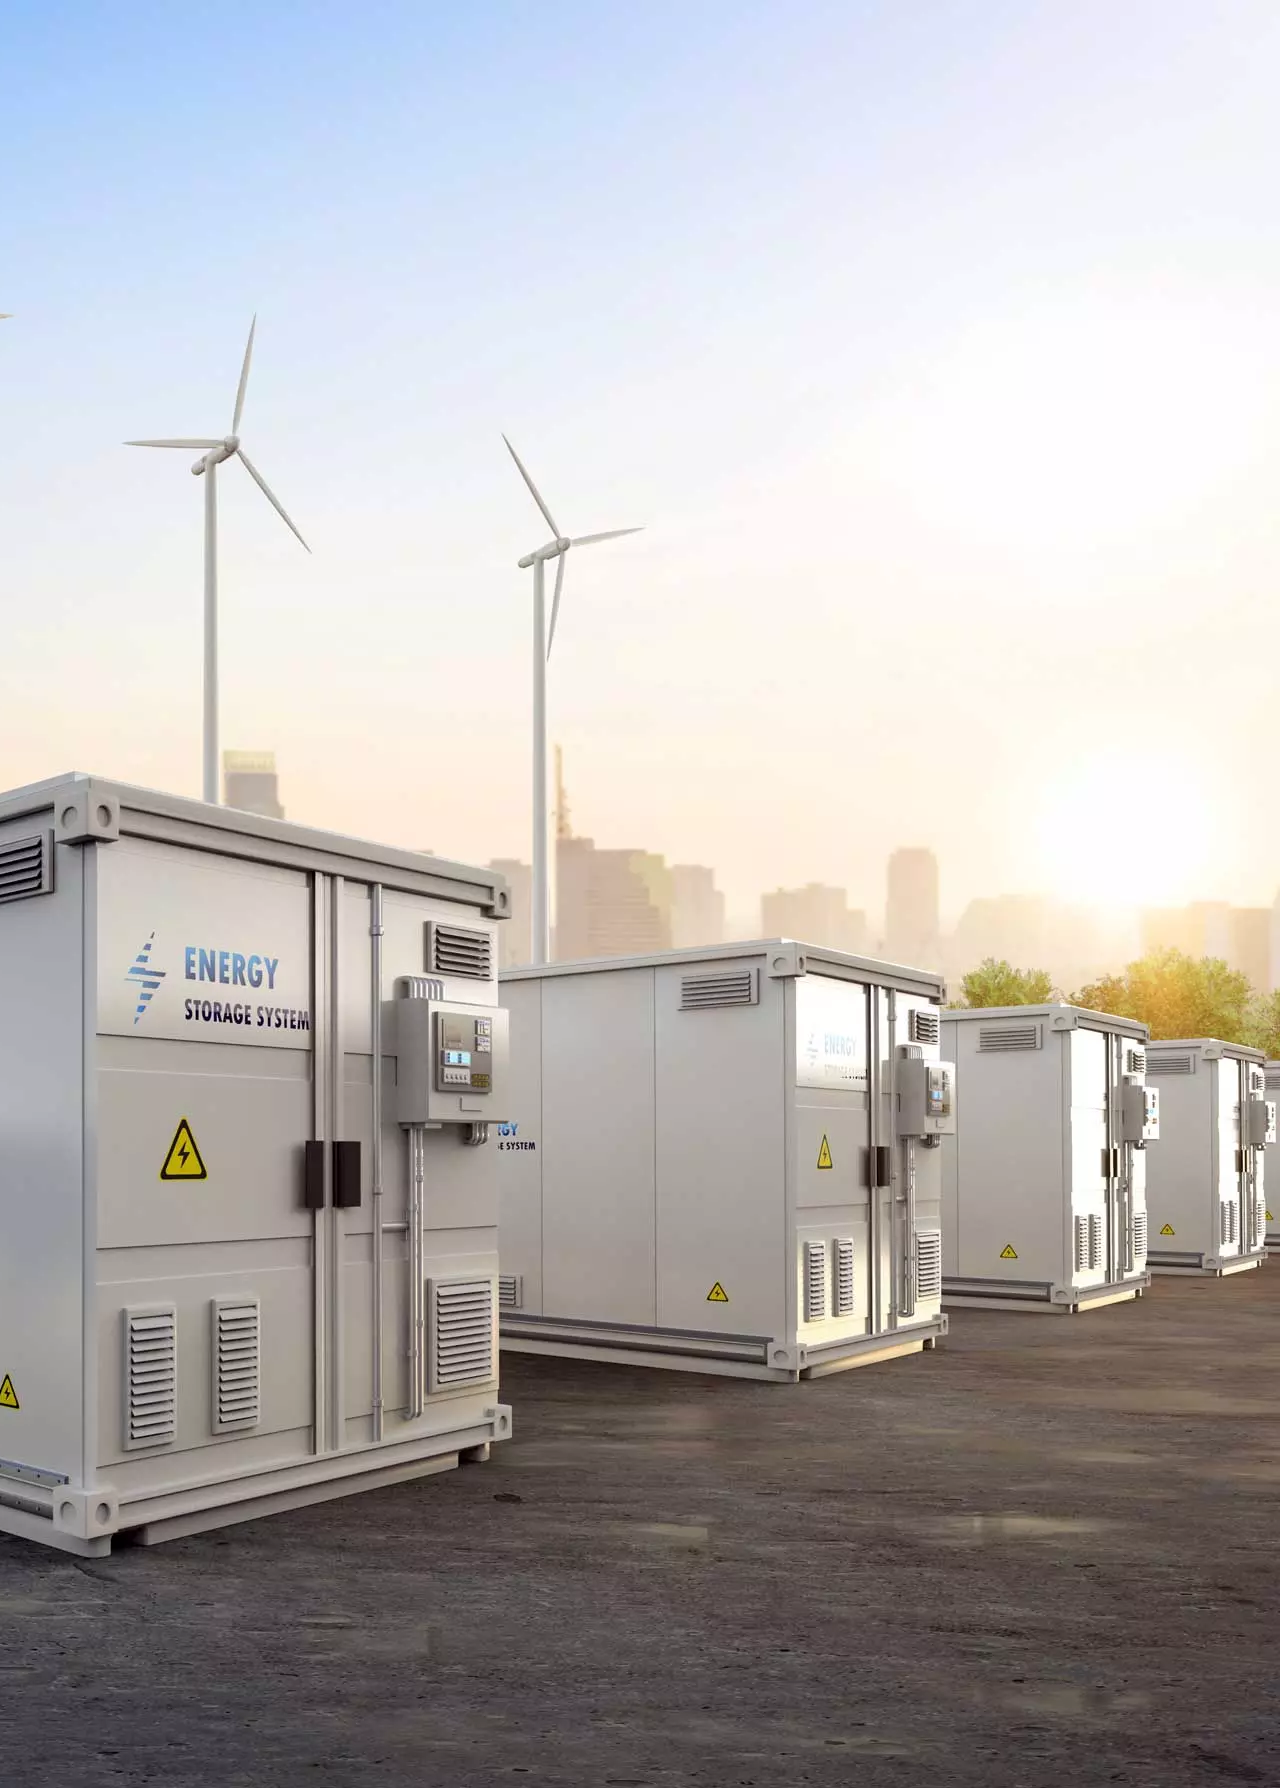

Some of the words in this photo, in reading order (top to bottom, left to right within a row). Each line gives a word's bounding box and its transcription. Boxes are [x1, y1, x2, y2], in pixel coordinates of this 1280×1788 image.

[185, 946, 279, 989] ENERGY
[185, 998, 252, 1025] STORAGE
[257, 1006, 310, 1030] SYSTEM
[506, 1141, 536, 1151] SYSTEM
